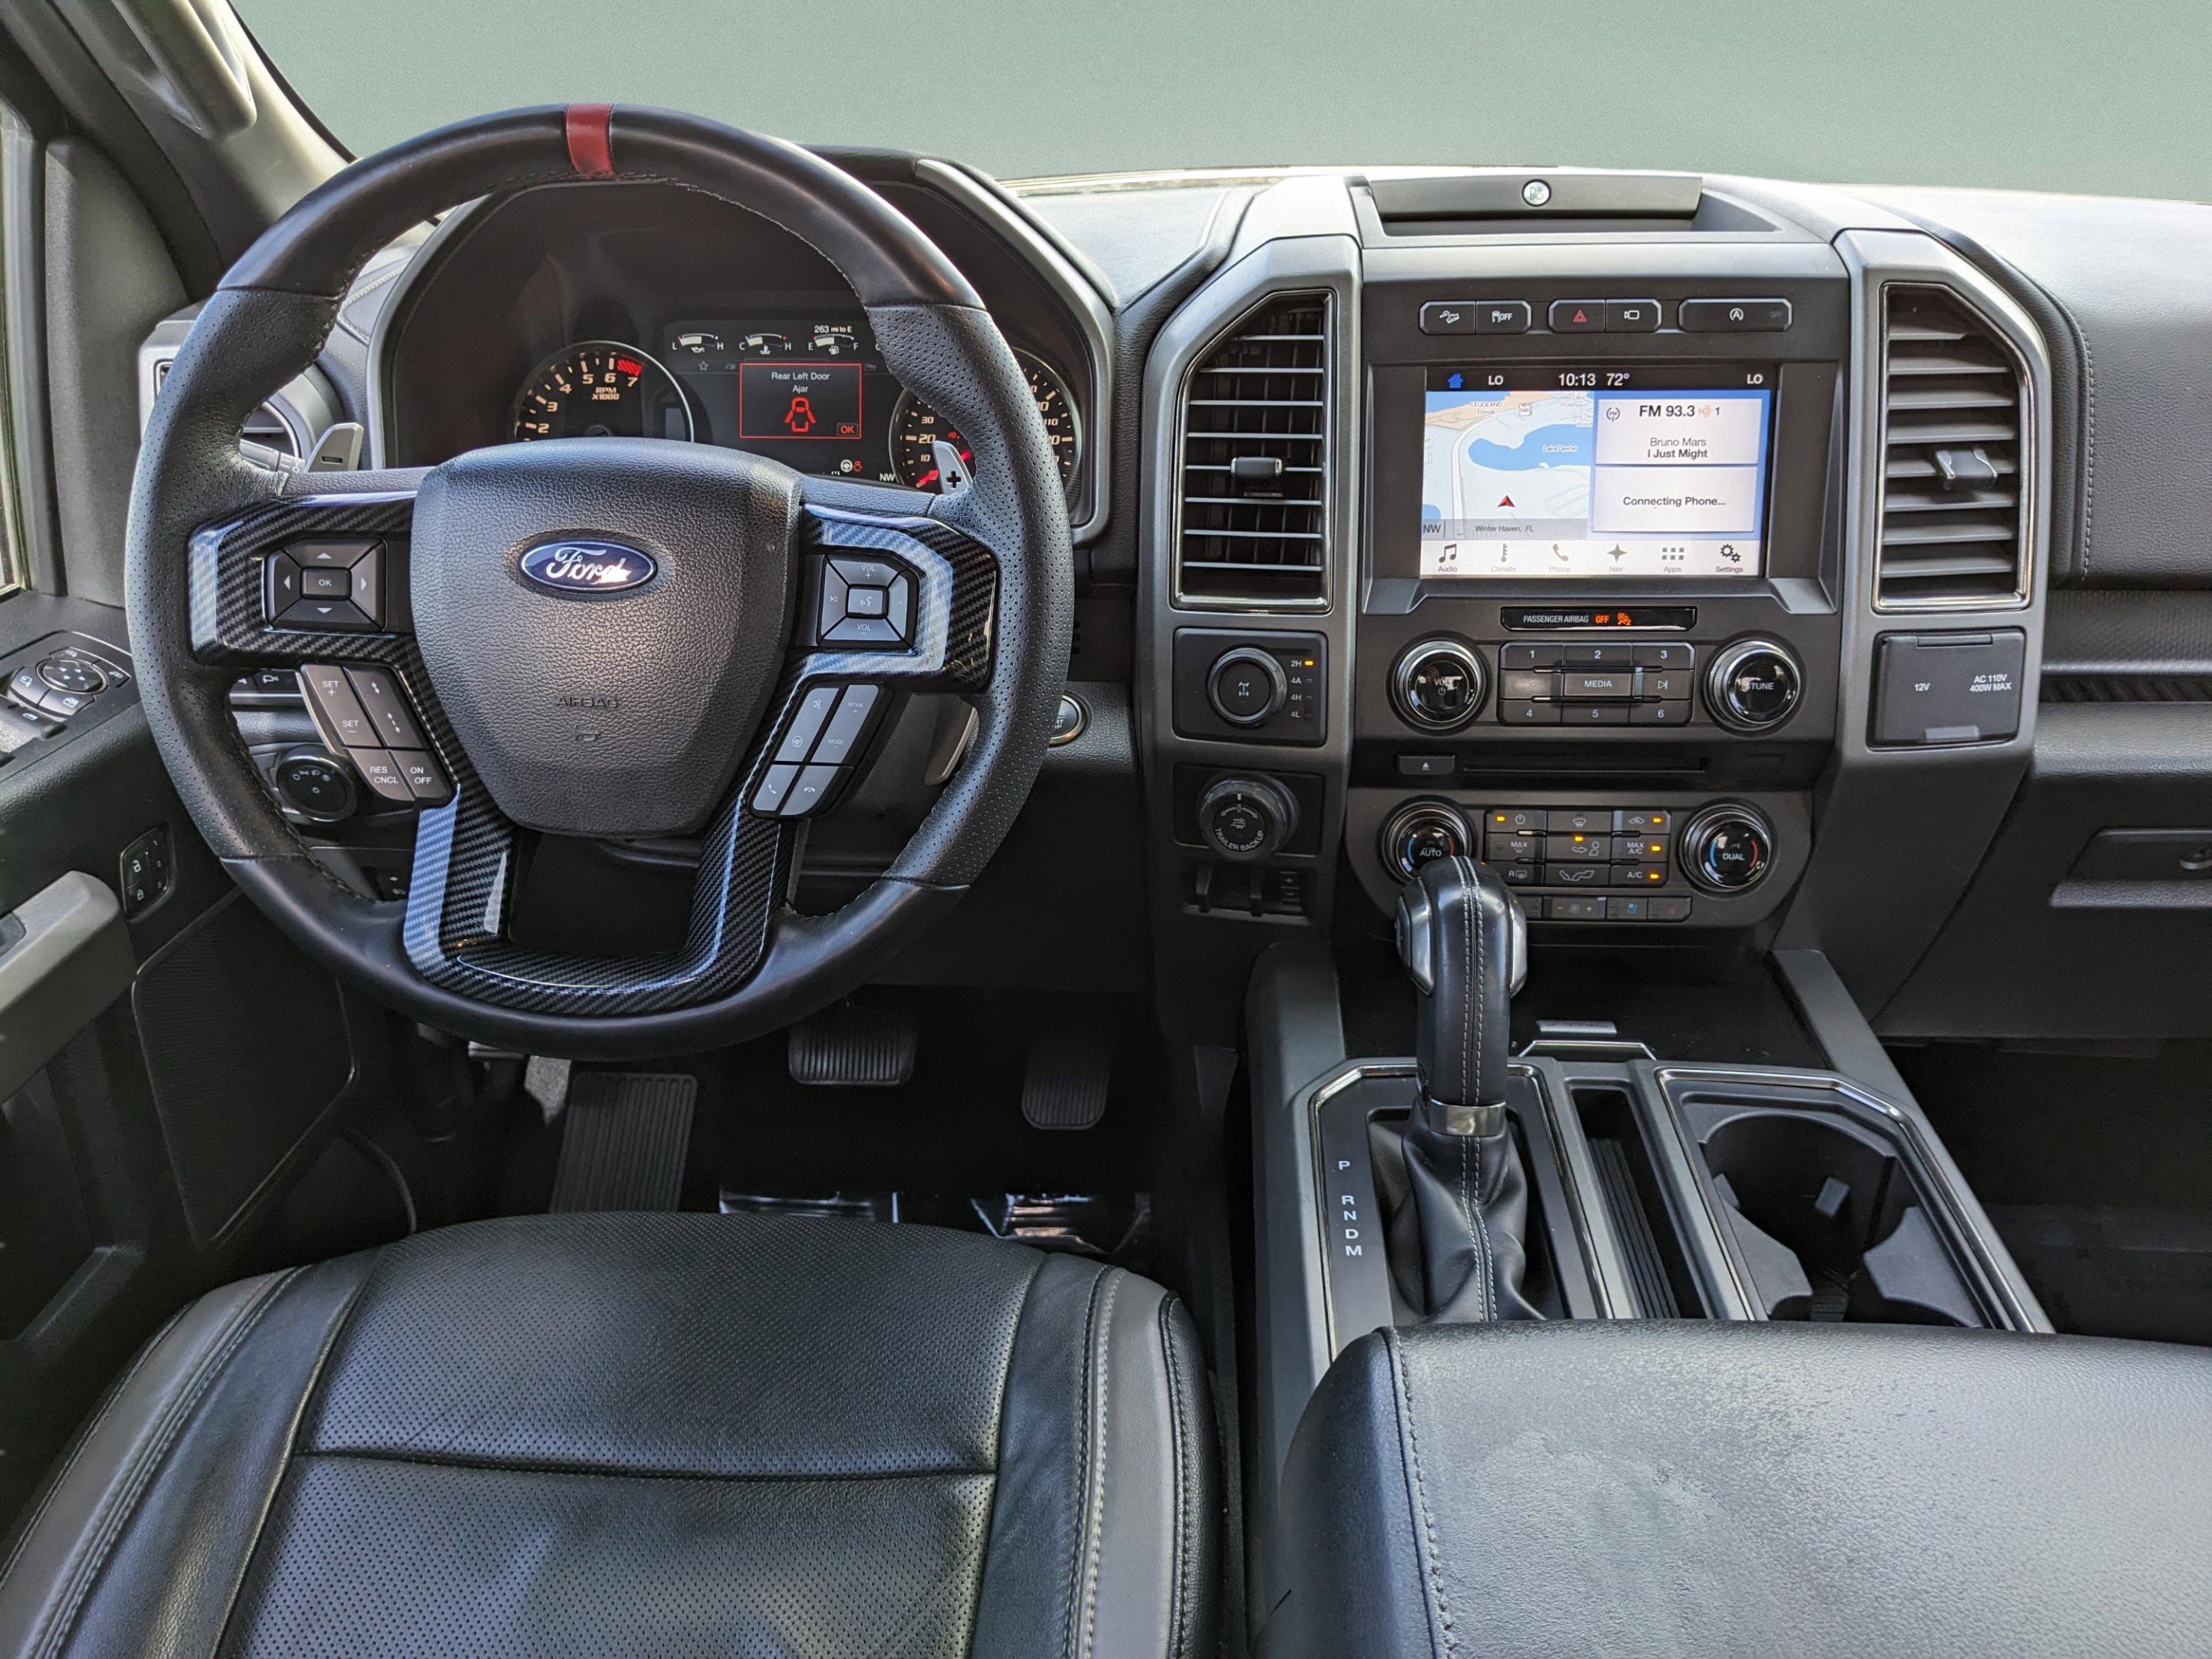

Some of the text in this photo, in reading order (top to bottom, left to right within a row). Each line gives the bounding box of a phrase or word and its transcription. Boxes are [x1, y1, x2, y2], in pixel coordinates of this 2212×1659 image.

[1500, 313, 1512, 321] OFF
[582, 374, 594, 384] 5
[604, 373, 616, 383] 6
[771, 372, 830, 380] Rear Left Door
[1488, 375, 1504, 385] LO
[1558, 373, 1596, 386] 10:13
[1747, 373, 1763, 384] LO
[628, 377, 638, 387] 7
[559, 384, 572, 393] 4
[793, 385, 809, 393] Ajar
[547, 402, 558, 412] 3
[1639, 406, 1661, 417] FM
[1666, 406, 1695, 417] 93.3
[1715, 407, 1720, 416] 1
[538, 423, 549, 433] 2
[840, 425, 854, 434] OK
[919, 434, 936, 444] 20
[1651, 438, 1707, 446] Bruno Mars
[1653, 449, 1676, 458] Just
[1678, 449, 1707, 459] Might
[879, 473, 896, 482] NW
[1623, 496, 1727, 507] Connecting Phone...
[1422, 525, 1442, 533] NW
[546, 547, 632, 583] Ford
[1715, 565, 1743, 575] Settings
[1664, 566, 1682, 575] Apps
[1595, 615, 1610, 624] OFF
[1529, 650, 1535, 659] 1
[1594, 650, 1601, 659] 2
[1661, 650, 1667, 659] 3
[1974, 674, 2008, 684] AC 110V
[1914, 683, 1931, 691] 12V
[1969, 682, 2012, 692] 400W MAX
[556, 695, 619, 708] AIRBAG
[1526, 709, 1533, 717] 4
[1592, 709, 1598, 717] 5
[1657, 709, 1664, 718] 6
[1215, 828, 1264, 851] TRAILER BACKUP
[1338, 1161, 1350, 1170] P
[1341, 1195, 1355, 1205] R
[1343, 1210, 1356, 1220] N
[1346, 1229, 1359, 1239] D
[1346, 1245, 1363, 1256] M
